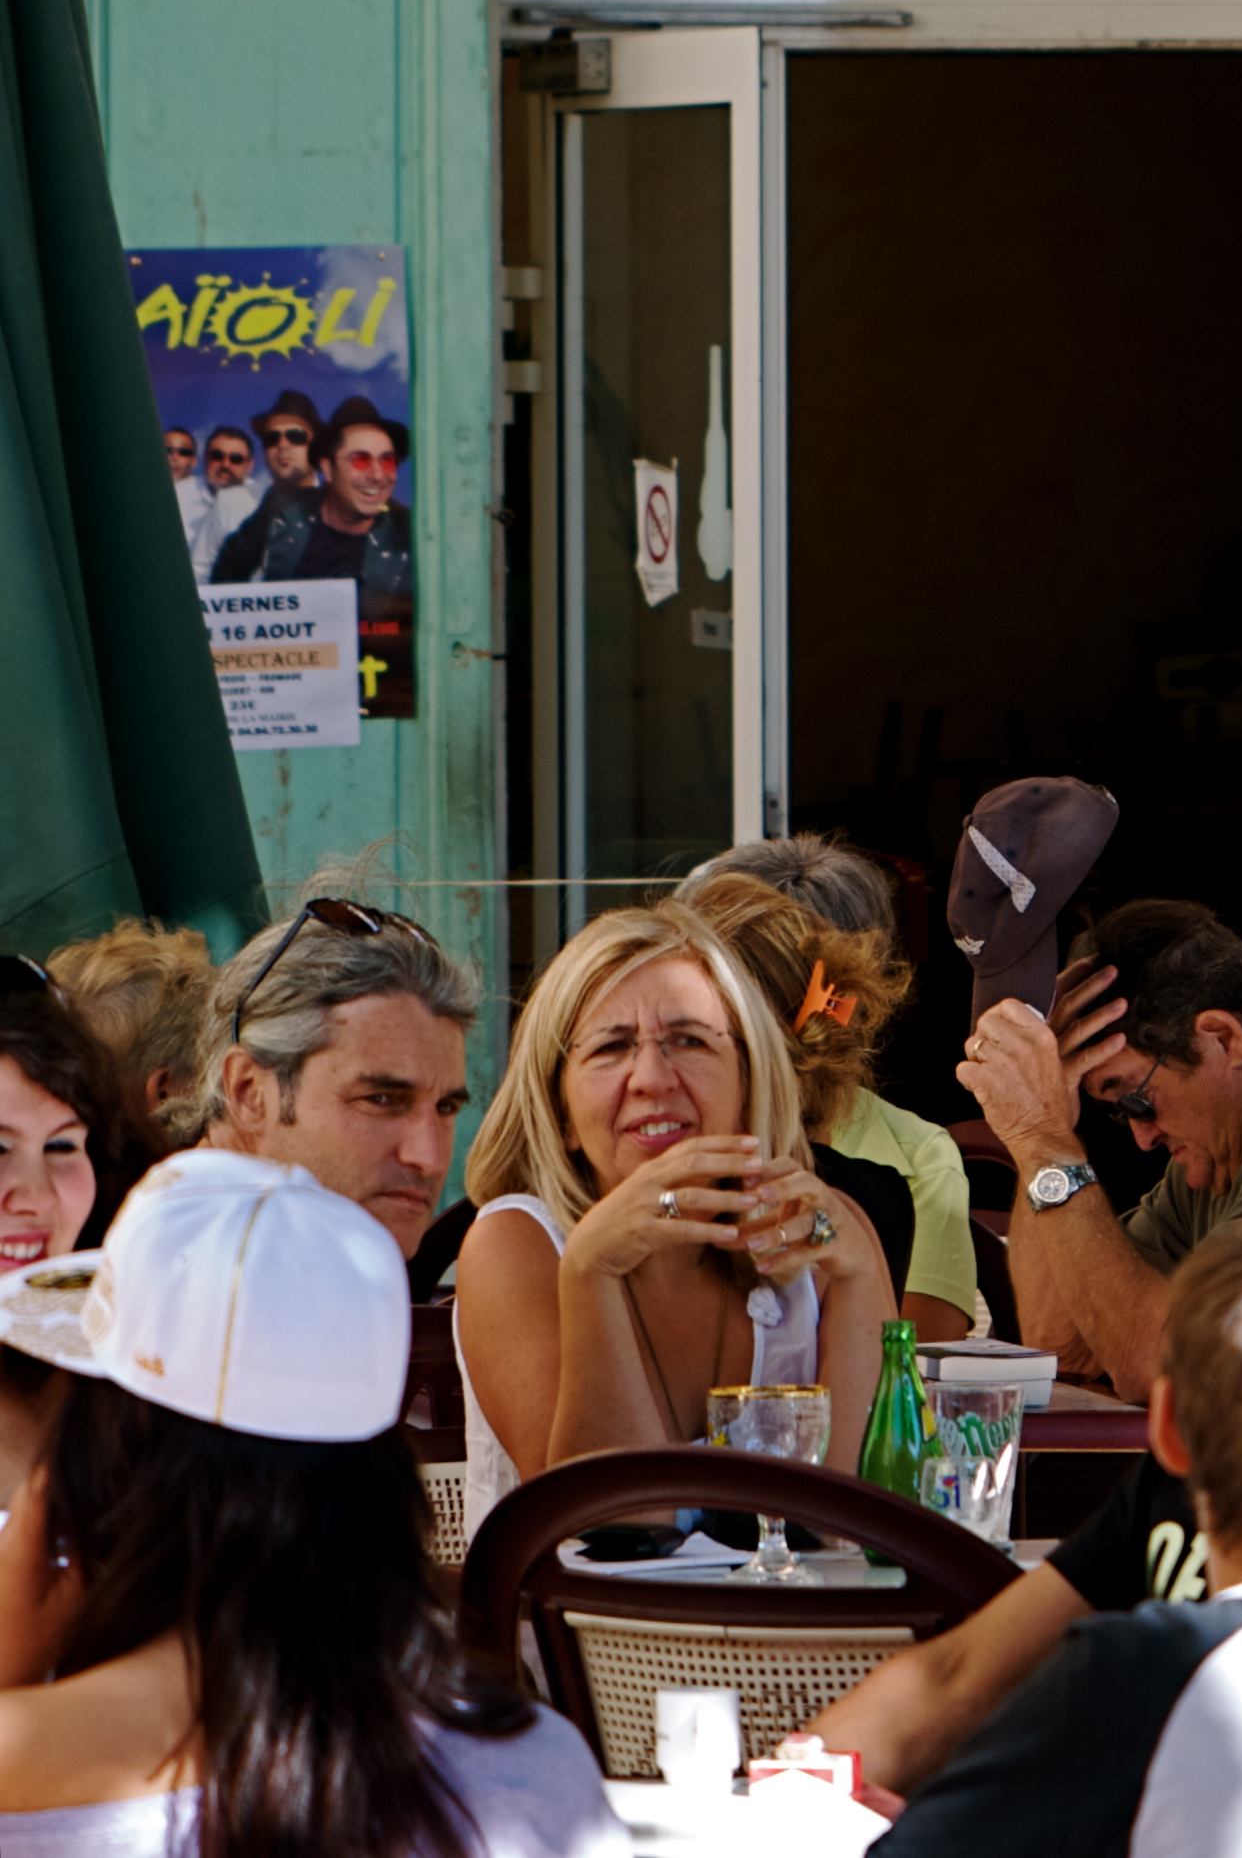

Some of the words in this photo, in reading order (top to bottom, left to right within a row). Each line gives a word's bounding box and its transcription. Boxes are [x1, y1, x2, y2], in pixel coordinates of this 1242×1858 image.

[221, 625, 246, 640] 16
[254, 622, 316, 640] AOUT
[214, 650, 320, 669] SPECTACLE
